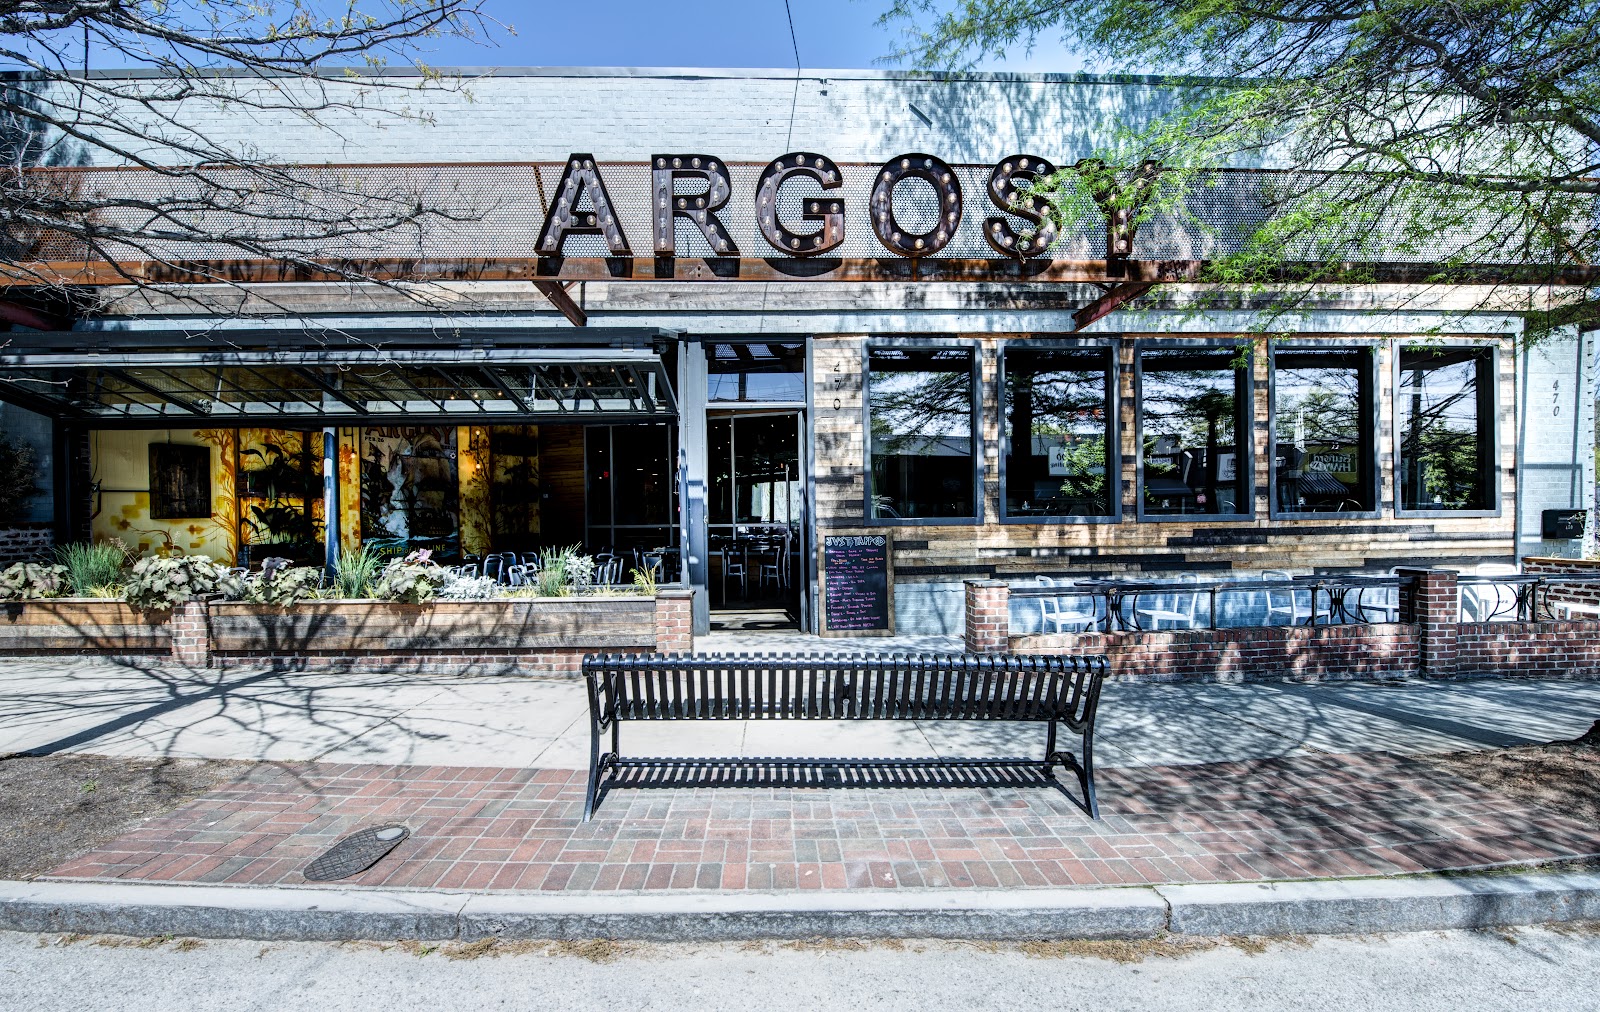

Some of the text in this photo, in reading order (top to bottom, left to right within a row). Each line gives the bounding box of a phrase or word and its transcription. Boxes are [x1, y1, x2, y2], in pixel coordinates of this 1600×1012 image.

[533, 151, 1160, 258] ARGOSY
[1552, 379, 1561, 417] 470
[379, 547, 403, 555] SHIP
